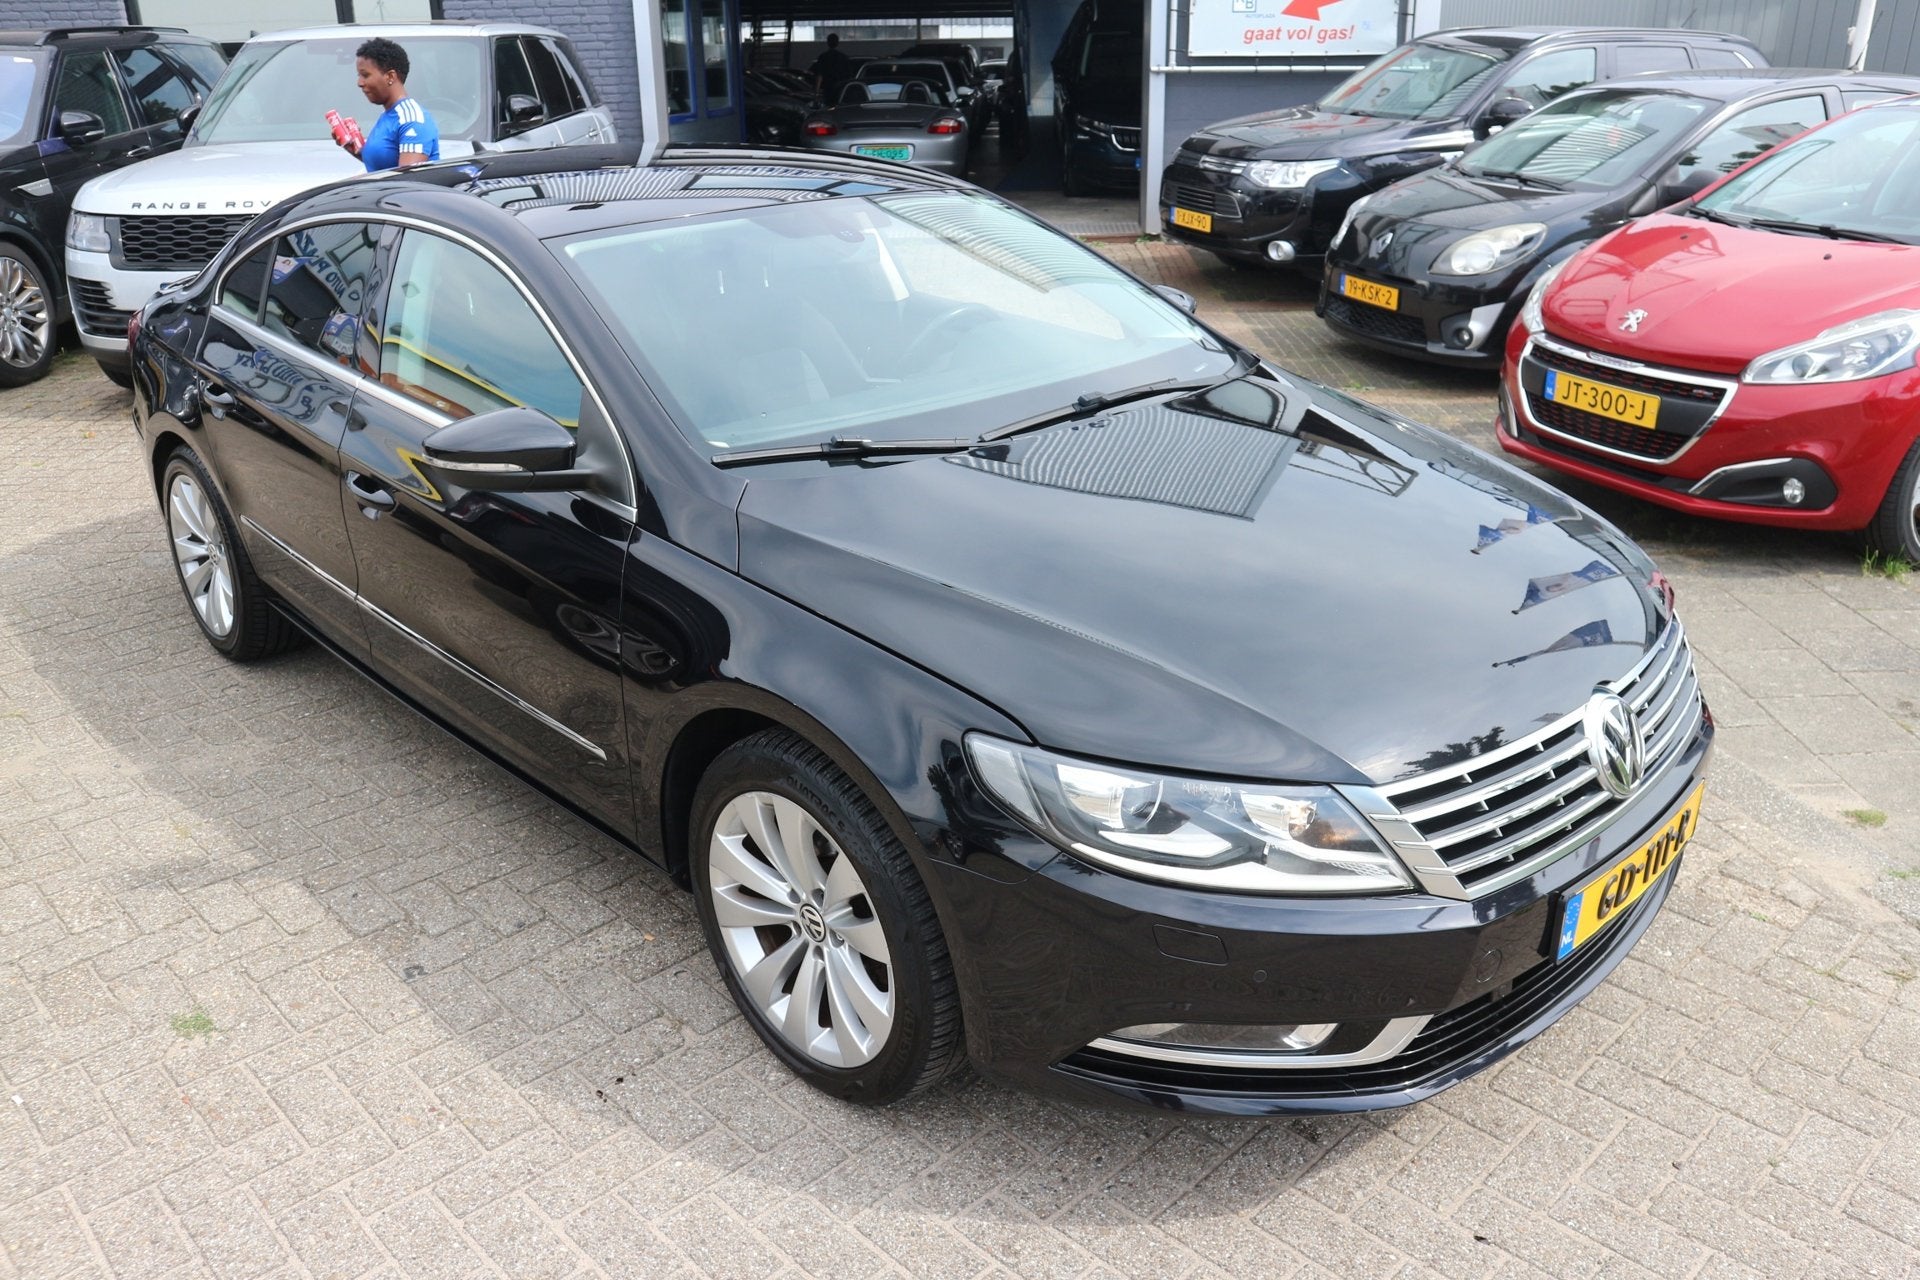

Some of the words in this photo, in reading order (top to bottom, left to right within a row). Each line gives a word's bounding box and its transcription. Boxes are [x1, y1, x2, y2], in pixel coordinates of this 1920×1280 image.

[1243, 26, 1282, 45] gaat
[1286, 25, 1313, 40] vol
[1316, 25, 1355, 44] gas!
[131, 202, 208, 210] RANGE
[224, 200, 272, 209] ROV
[1348, 279, 1393, 306] 19-KSK-2
[1562, 380, 1647, 421] JT-300-J
[1560, 931, 1573, 948] NL
